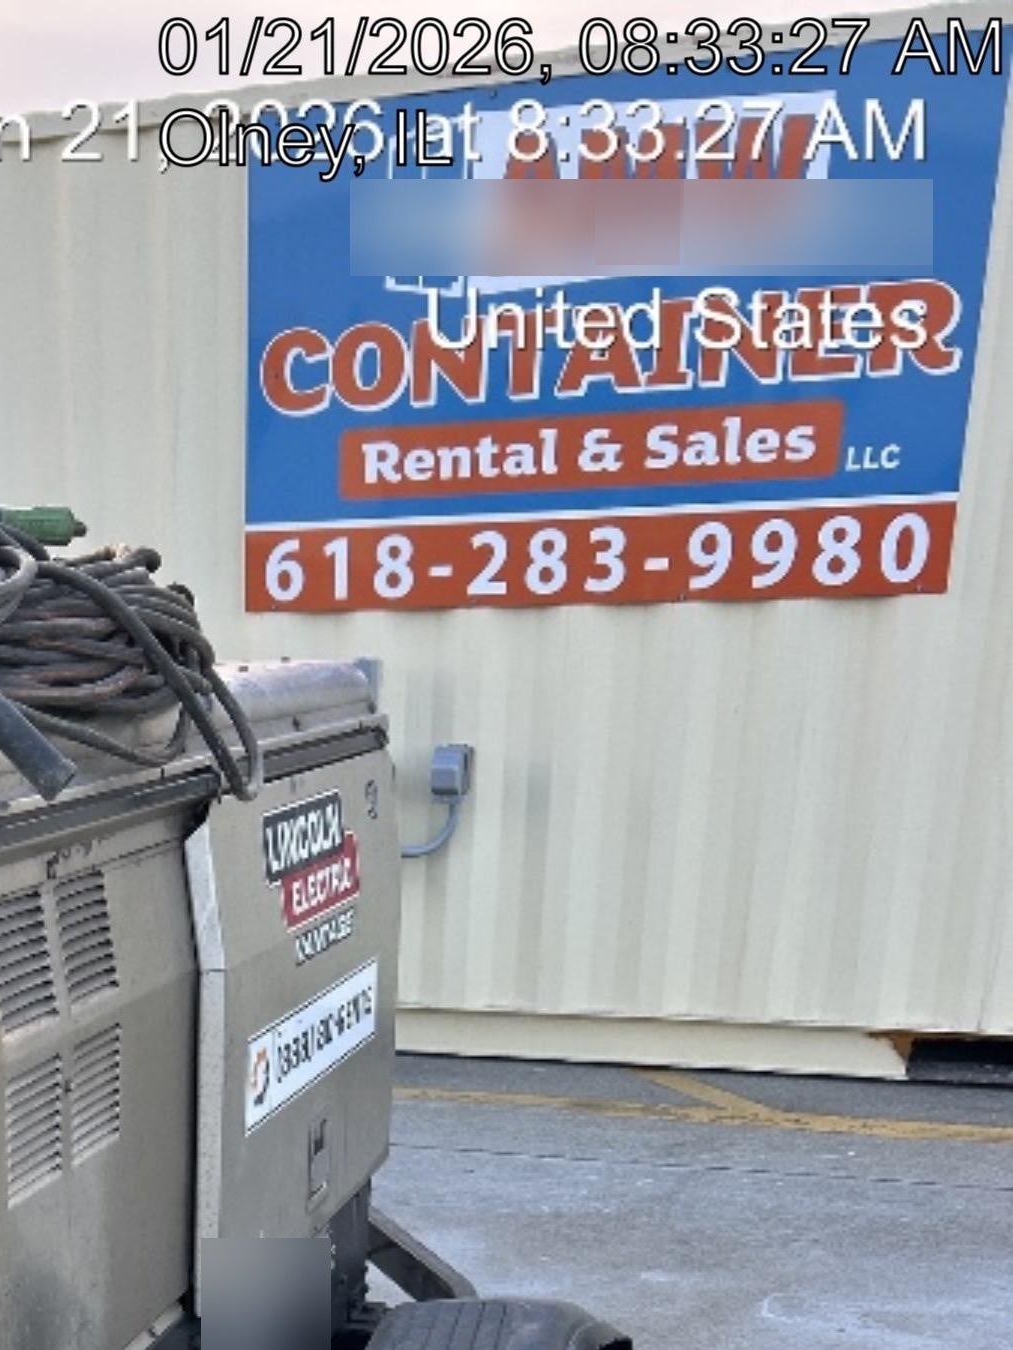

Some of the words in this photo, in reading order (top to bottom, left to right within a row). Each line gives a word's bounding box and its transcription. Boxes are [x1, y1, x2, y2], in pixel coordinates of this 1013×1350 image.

[260, 278, 964, 416] CONTAINER
[362, 428, 558, 484] Rental
[577, 427, 624, 473] &
[644, 417, 816, 471] Sales
[845, 443, 901, 472] LLC
[264, 513, 930, 602] 618-283-9980
